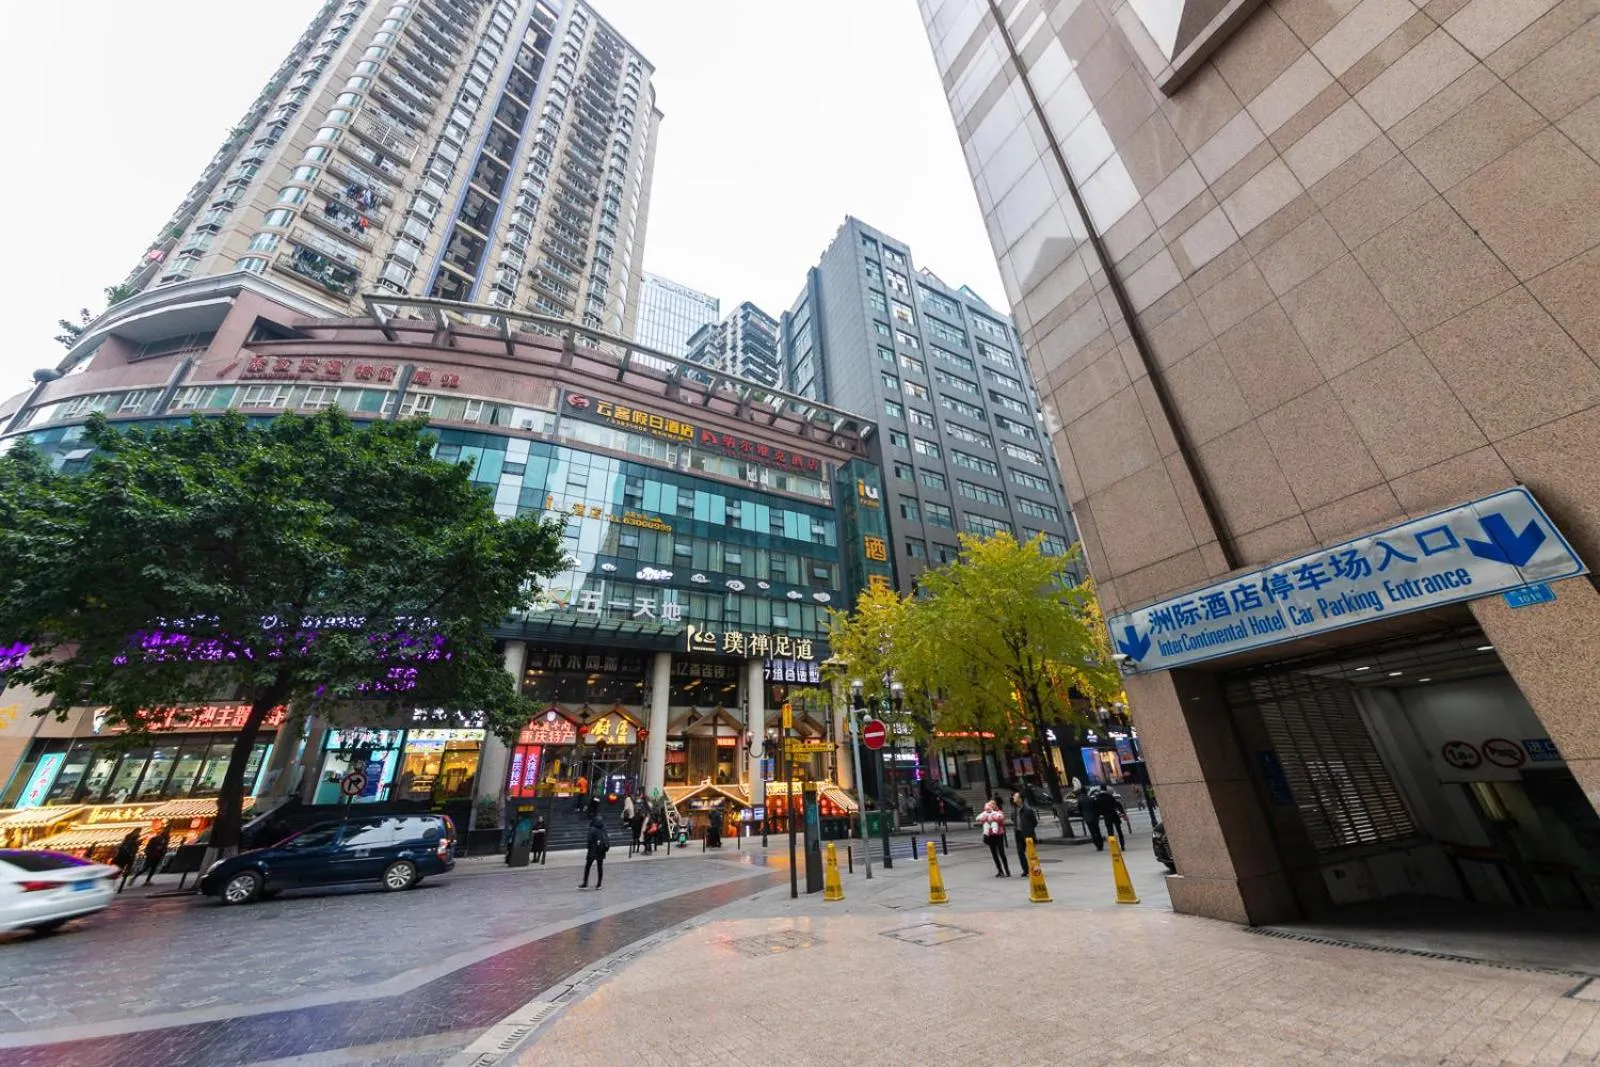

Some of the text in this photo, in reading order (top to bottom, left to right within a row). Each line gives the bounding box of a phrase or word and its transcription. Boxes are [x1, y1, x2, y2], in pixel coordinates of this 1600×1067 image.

[577, 589, 682, 621] 五一天地
[1148, 525, 1460, 635] 洲际酒店停车场入口
[1158, 567, 1472, 657] InterContinental Hotel Car Parking Entrance
[520, 730, 577, 743] 重庆特产
